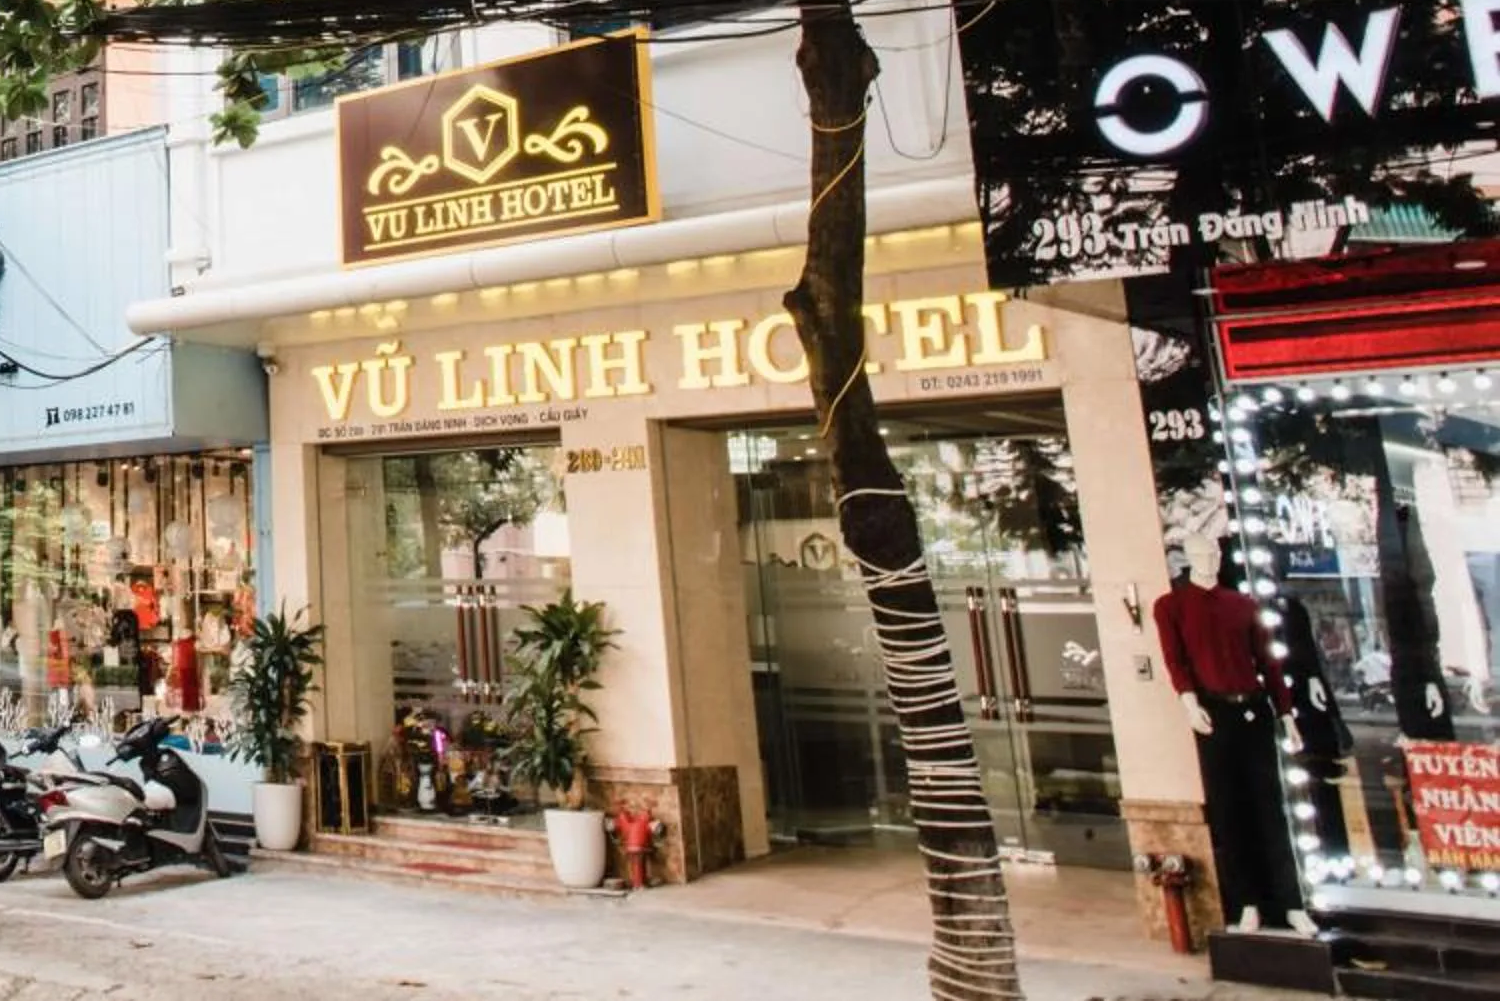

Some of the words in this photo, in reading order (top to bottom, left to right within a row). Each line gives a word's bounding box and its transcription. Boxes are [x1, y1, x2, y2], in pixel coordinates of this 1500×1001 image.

[456, 112, 503, 162] V
[366, 208, 408, 241] VU
[416, 189, 494, 234] LINH
[501, 173, 615, 220] HOTEL
[1032, 209, 1108, 261] 293
[311, 339, 414, 420] VŨ
[436, 330, 654, 411] LINH
[1149, 408, 1205, 442] 293
